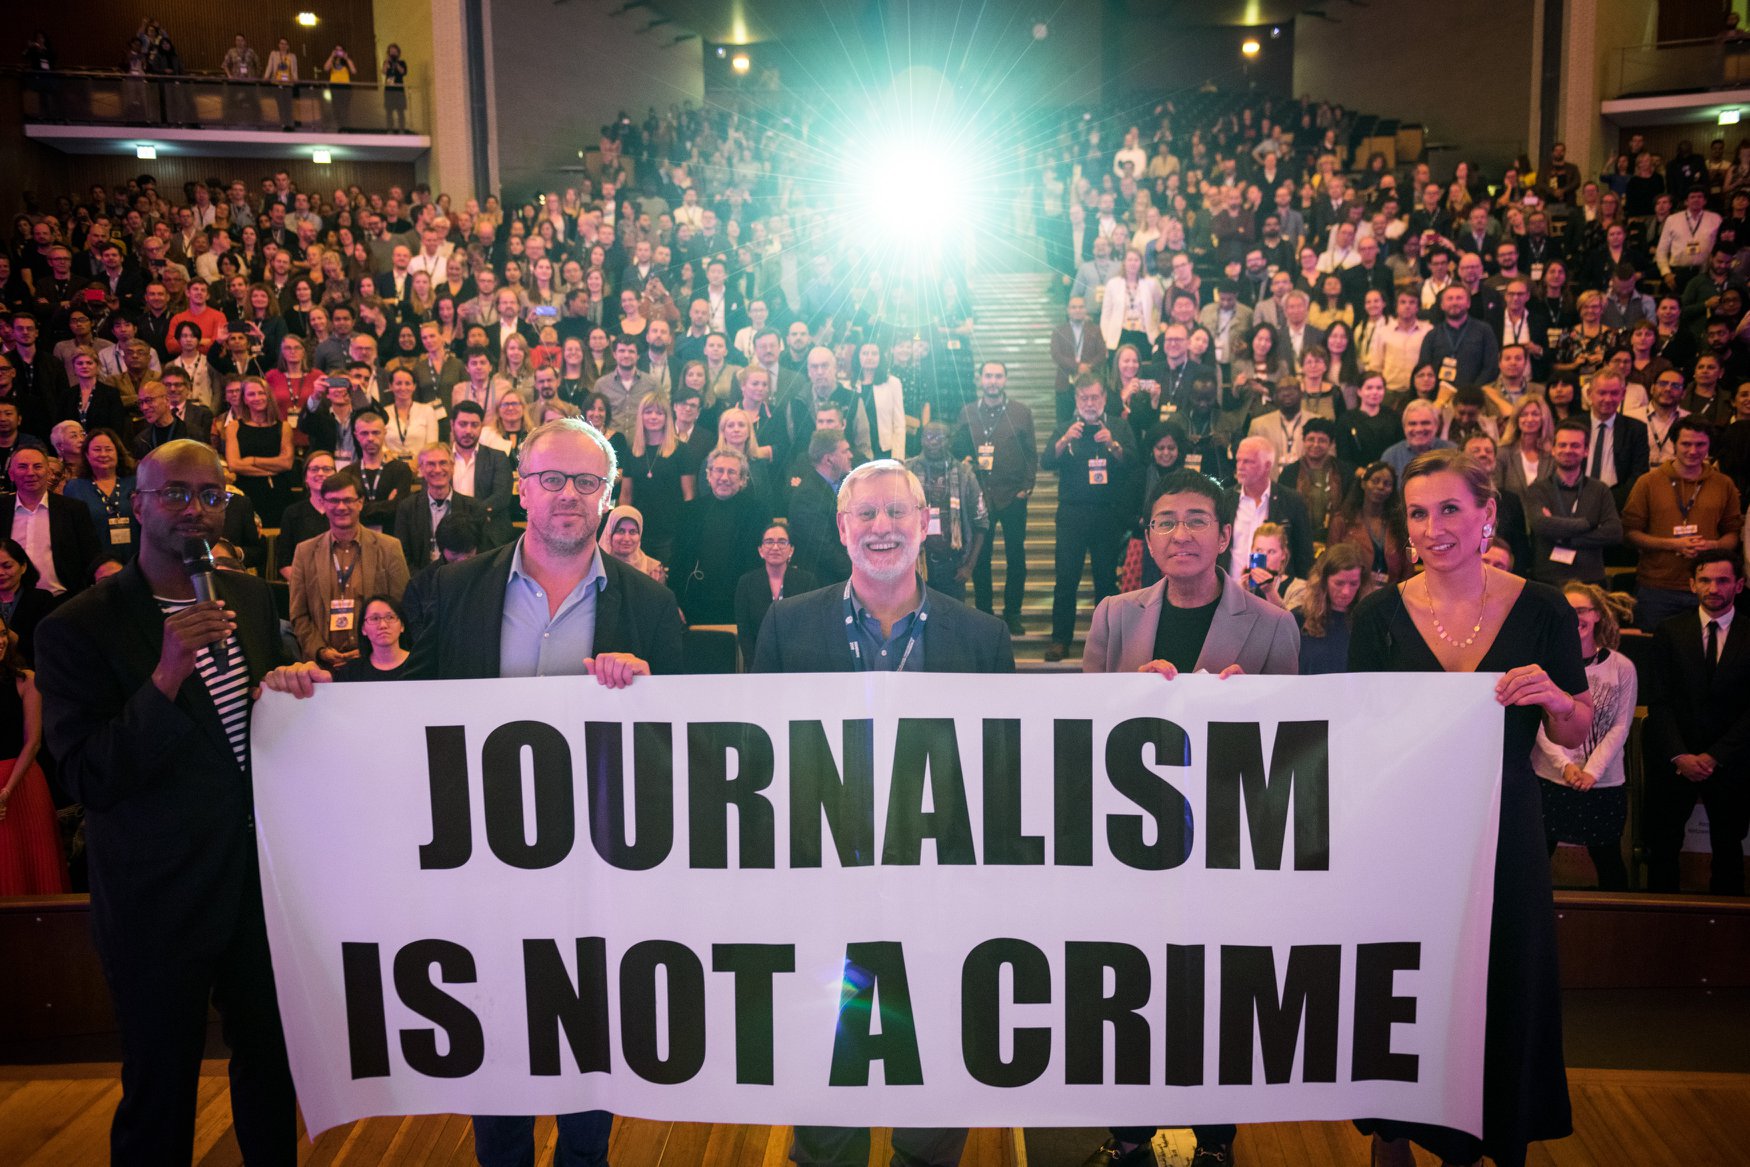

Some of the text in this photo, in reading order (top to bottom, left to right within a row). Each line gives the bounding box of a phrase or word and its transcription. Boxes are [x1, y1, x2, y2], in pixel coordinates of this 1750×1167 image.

[419, 717, 1330, 871] JOURNALISM
[342, 937, 1422, 1089] IS NOT A CRIME
